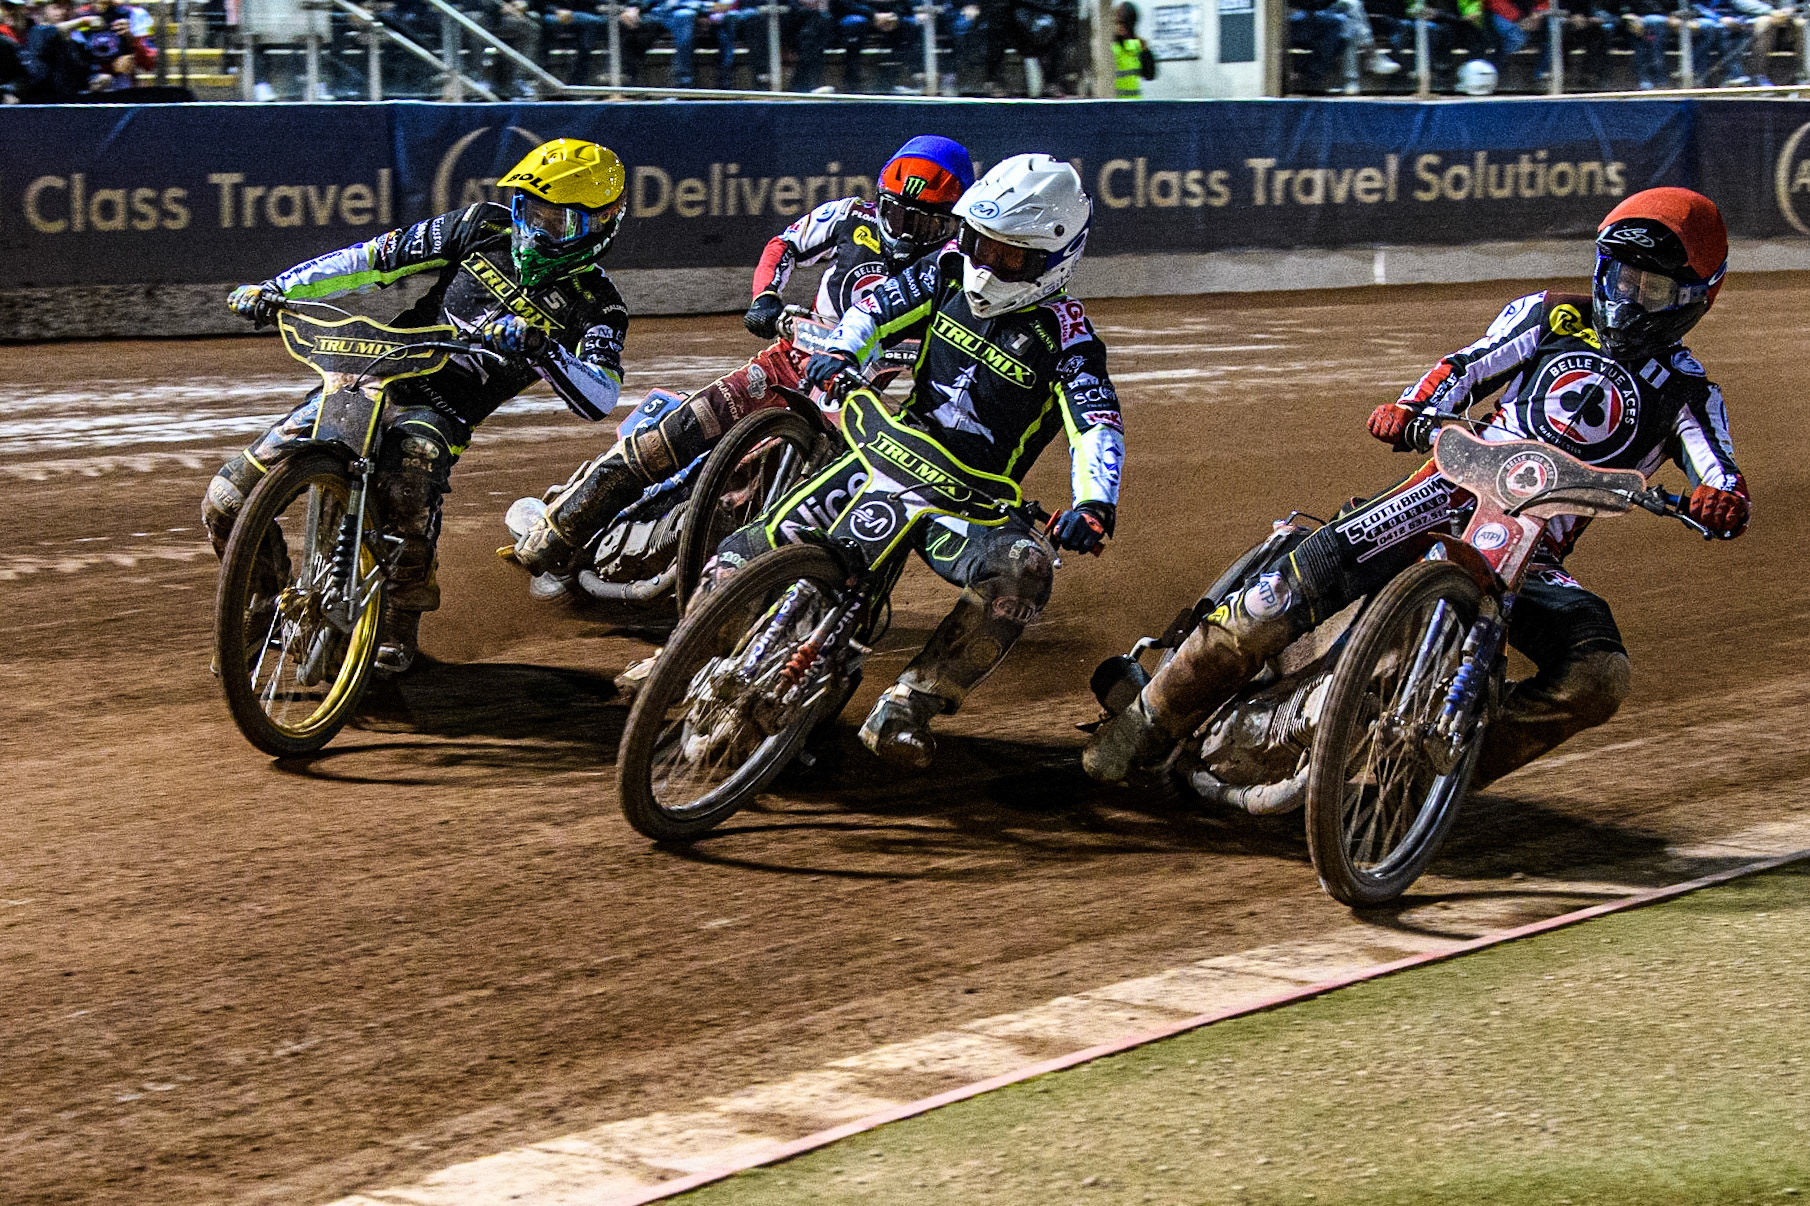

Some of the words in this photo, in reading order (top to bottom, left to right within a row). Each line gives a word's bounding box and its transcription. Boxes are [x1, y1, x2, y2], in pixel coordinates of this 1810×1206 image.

[24, 173, 191, 233] Class
[207, 168, 393, 228] Travel
[632, 161, 881, 217] Deliverin
[1099, 157, 1232, 208] Class
[1245, 154, 1398, 205] Travel
[1413, 150, 1627, 201] Solutions
[471, 259, 515, 298] TRU
[854, 265, 882, 278] BELLE
[320, 339, 351, 352] TRU
[1060, 296, 1087, 340] GK
[937, 319, 983, 352] TRU
[981, 346, 1031, 383] MIX
[1549, 358, 1592, 377] BELLE
[1600, 363, 1626, 386] VUE
[1623, 389, 1636, 425] ACES
[877, 438, 918, 468] TRU
[914, 463, 956, 496] MIX
[1347, 500, 1400, 537] SCOTT
[1400, 477, 1457, 506] BROWN
[1368, 496, 1445, 535] FLOORING
[1478, 531, 1502, 542] ATPI
